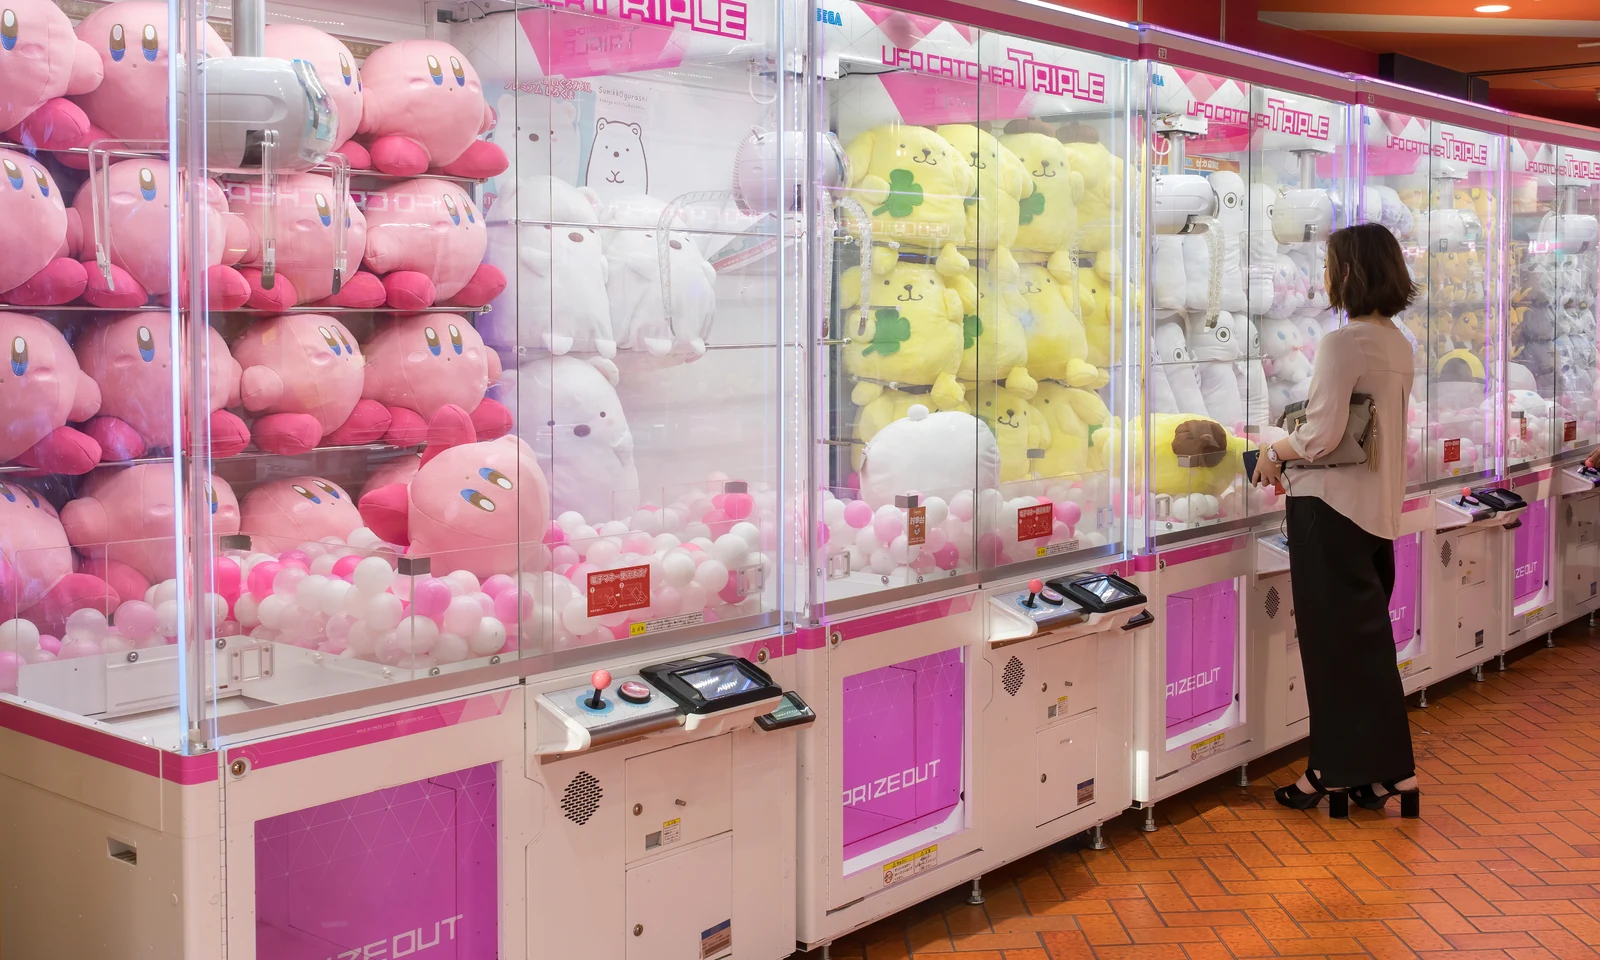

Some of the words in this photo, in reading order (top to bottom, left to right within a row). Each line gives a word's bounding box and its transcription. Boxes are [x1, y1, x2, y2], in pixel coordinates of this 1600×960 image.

[816, 8, 842, 26] SEGA
[882, 45, 924, 71] UFO
[927, 53, 1014, 87] CATCHER
[1006, 47, 1105, 103] TRIPLE
[1186, 100, 1214, 120] UFO
[1214, 105, 1270, 130] CATCHER
[1267, 97, 1330, 140] TRIPLE
[1386, 135, 1405, 151] UFO
[1405, 139, 1445, 157] CATCHER
[1441, 131, 1487, 165] TRIPLE
